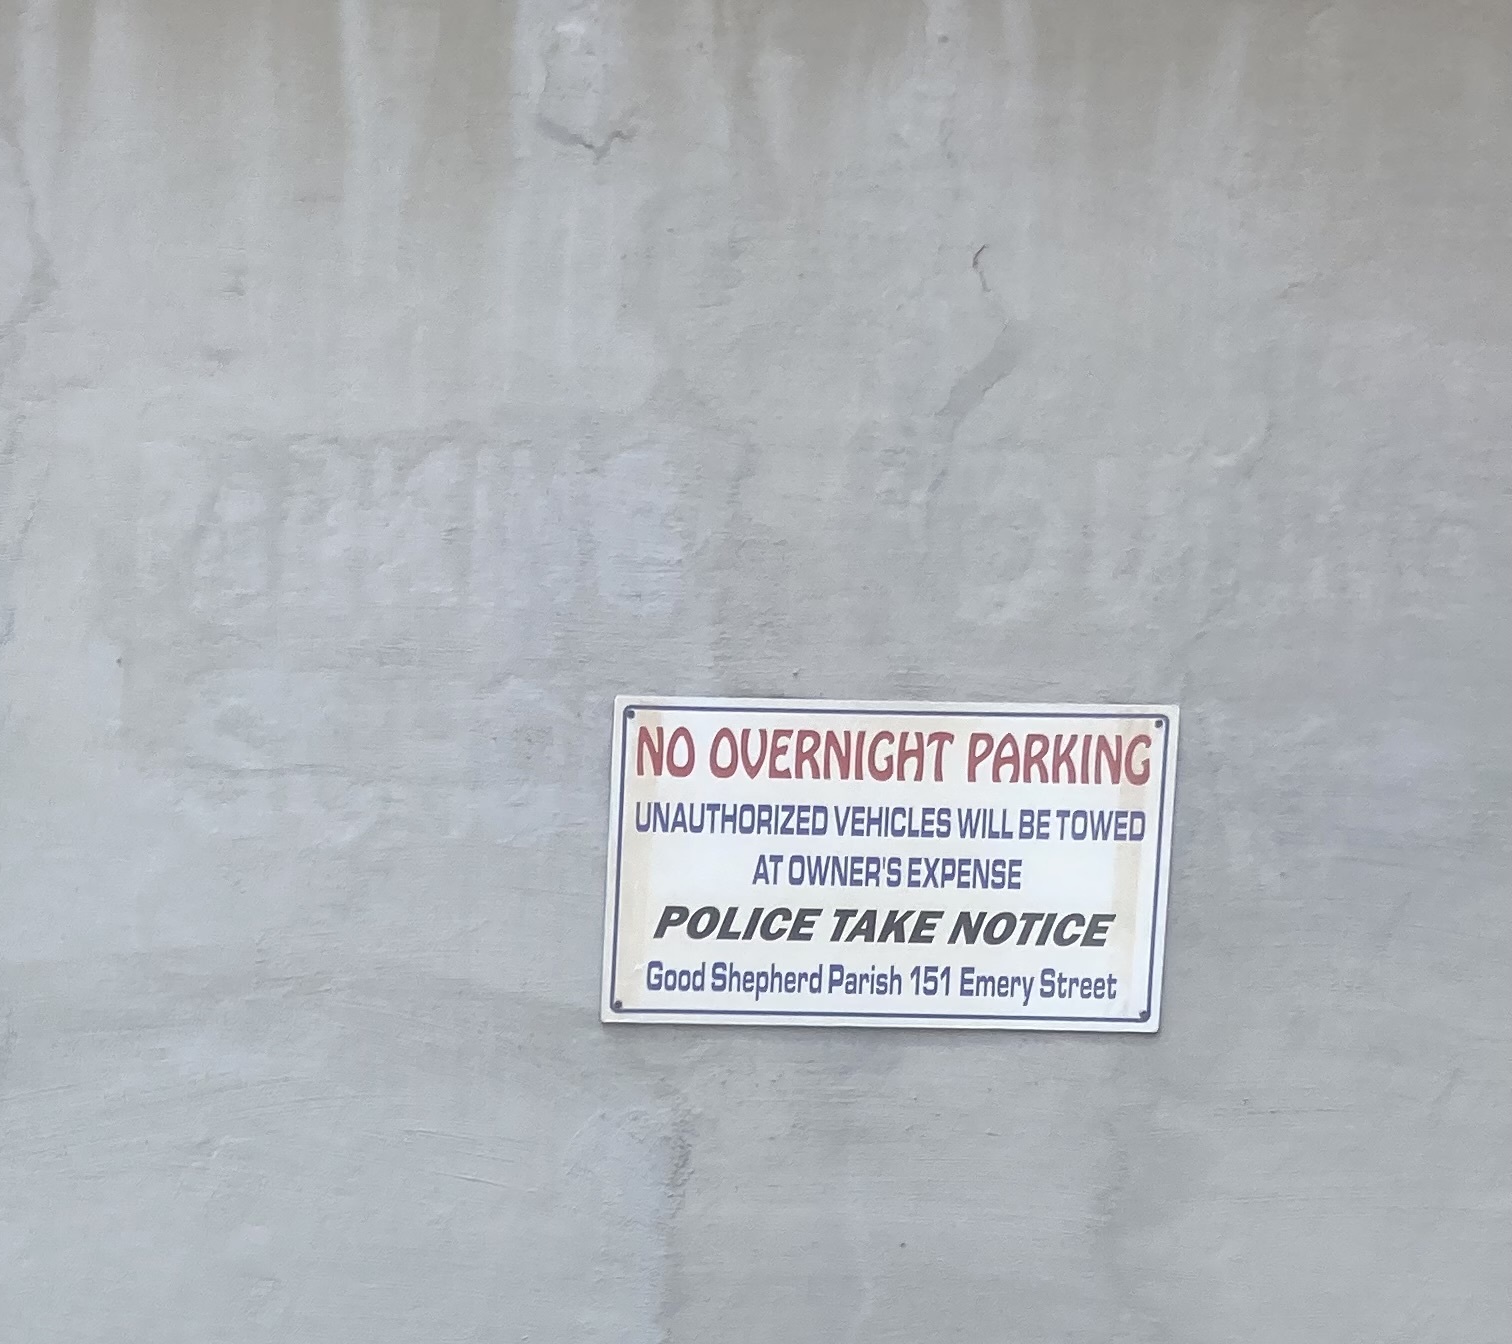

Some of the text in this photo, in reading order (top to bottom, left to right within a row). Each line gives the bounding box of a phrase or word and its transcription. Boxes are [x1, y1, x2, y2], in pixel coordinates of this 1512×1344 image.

[637, 726, 1152, 786] NO OVERNIGHT PARKING
[636, 802, 1146, 842] UNAUTHORIZED VEHICLES WILL BE TOWED
[752, 854, 1023, 890] AT OWNER'S EXPENSE
[653, 905, 1117, 947] POLICE TAKE NOTICE
[646, 960, 1118, 1006] Good Shepherd Parish 151 Emery Street
